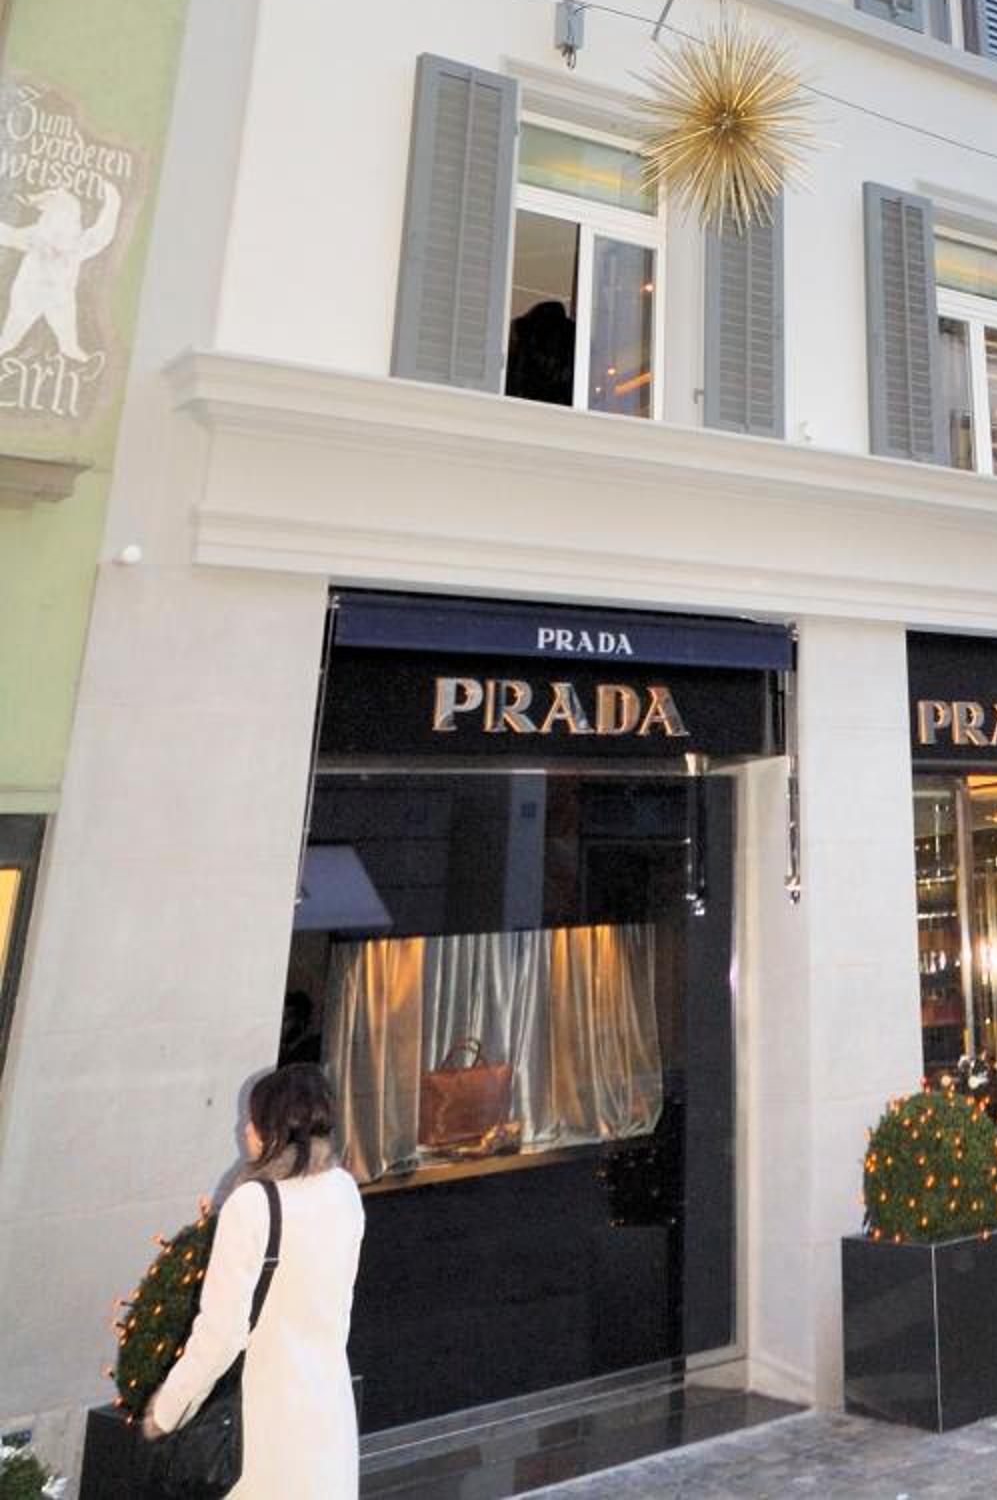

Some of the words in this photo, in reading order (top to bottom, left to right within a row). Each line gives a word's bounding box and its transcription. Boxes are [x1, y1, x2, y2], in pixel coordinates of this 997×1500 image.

[6, 84, 73, 141] Zum
[31, 130, 132, 179] vorderen
[537, 627, 634, 656] PRADA
[431, 675, 692, 738] PRADA
